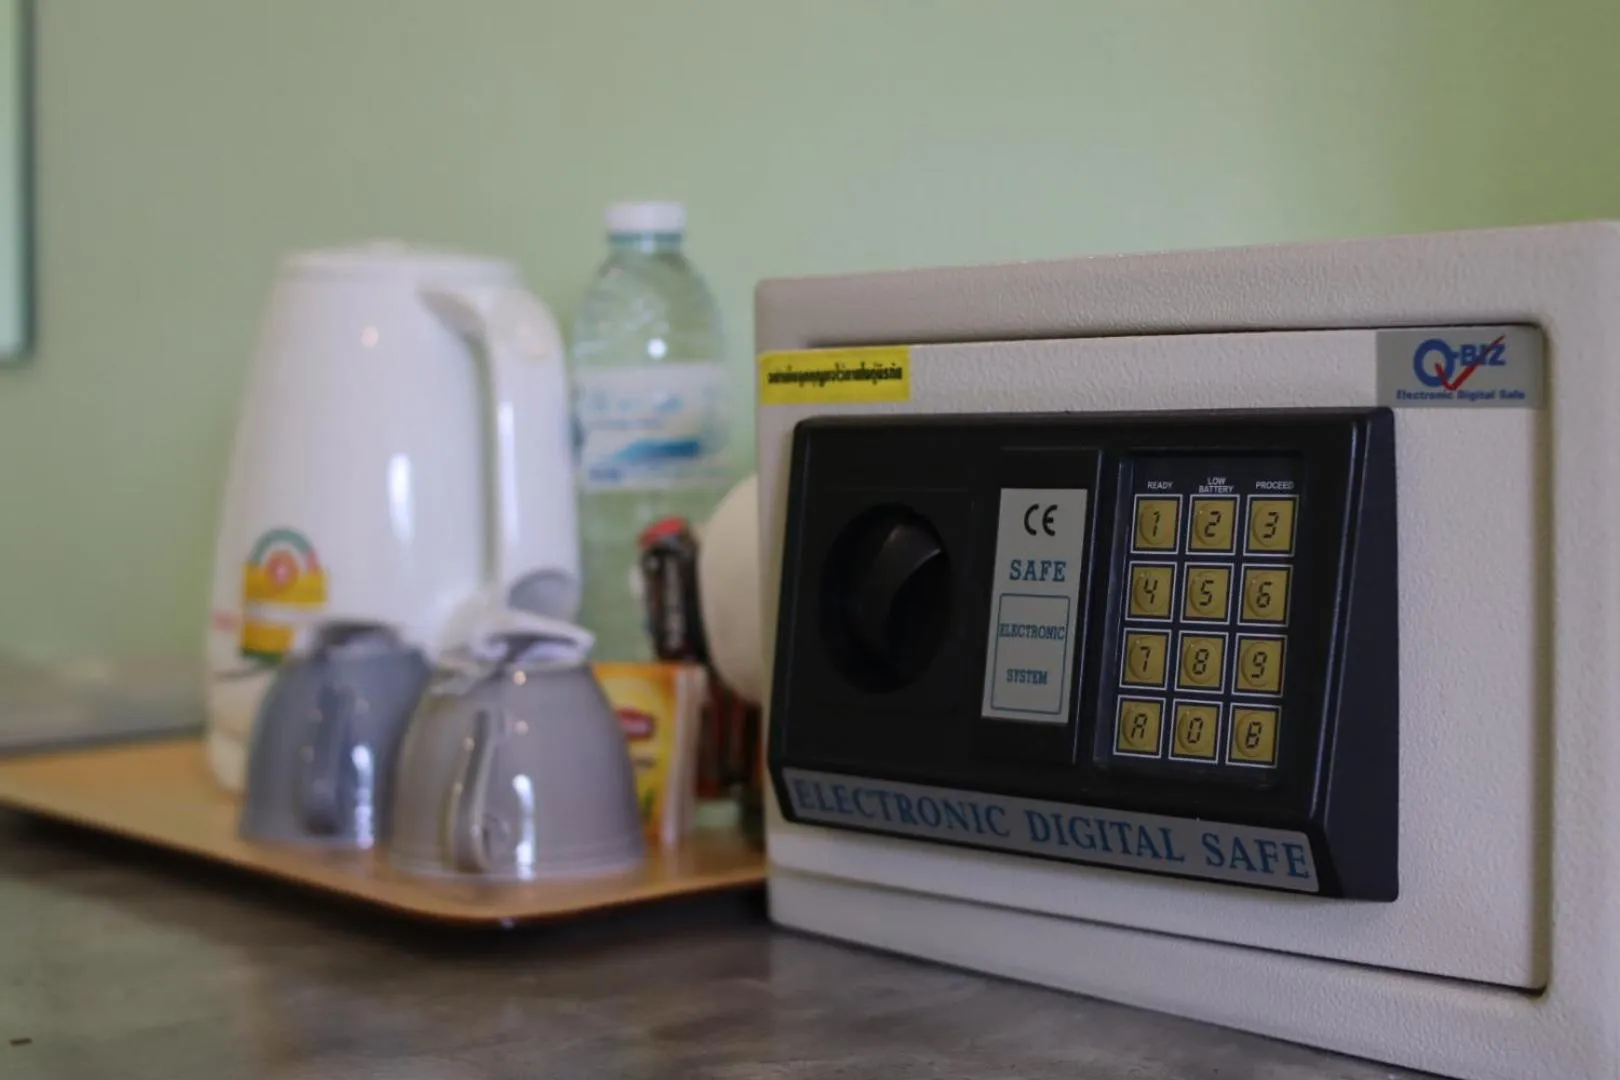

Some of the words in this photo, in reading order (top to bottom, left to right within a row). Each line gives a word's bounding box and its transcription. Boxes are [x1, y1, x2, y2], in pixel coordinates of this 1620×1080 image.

[1396, 389, 1452, 400] Electronic
[1457, 389, 1495, 401] Digital
[1499, 389, 1525, 400] Safe
[1147, 481, 1173, 489] READY
[1199, 485, 1233, 494] BATTERY
[1207, 477, 1226, 486] LOW
[1256, 481, 1294, 490] PROCEED
[1024, 504, 1058, 536] CE
[1152, 511, 1160, 537] 1
[1204, 511, 1221, 537] 2
[1263, 512, 1279, 538] 3
[1009, 559, 1066, 582] SAFE
[1143, 579, 1158, 604] 4
[1199, 580, 1214, 606] 5
[1256, 581, 1273, 608] 6
[1000, 623, 1065, 640] ELECTRONIC
[1140, 646, 1151, 672] 7
[1192, 649, 1210, 675] 8
[1251, 651, 1267, 678] 9
[1006, 668, 1048, 684] SYSTEM
[1131, 713, 1148, 739] A
[1187, 717, 1204, 743] 0
[792, 778, 1010, 837] ELECTRONIC
[1024, 809, 1185, 862] DIGITAL
[1202, 832, 1311, 879] SAFE
